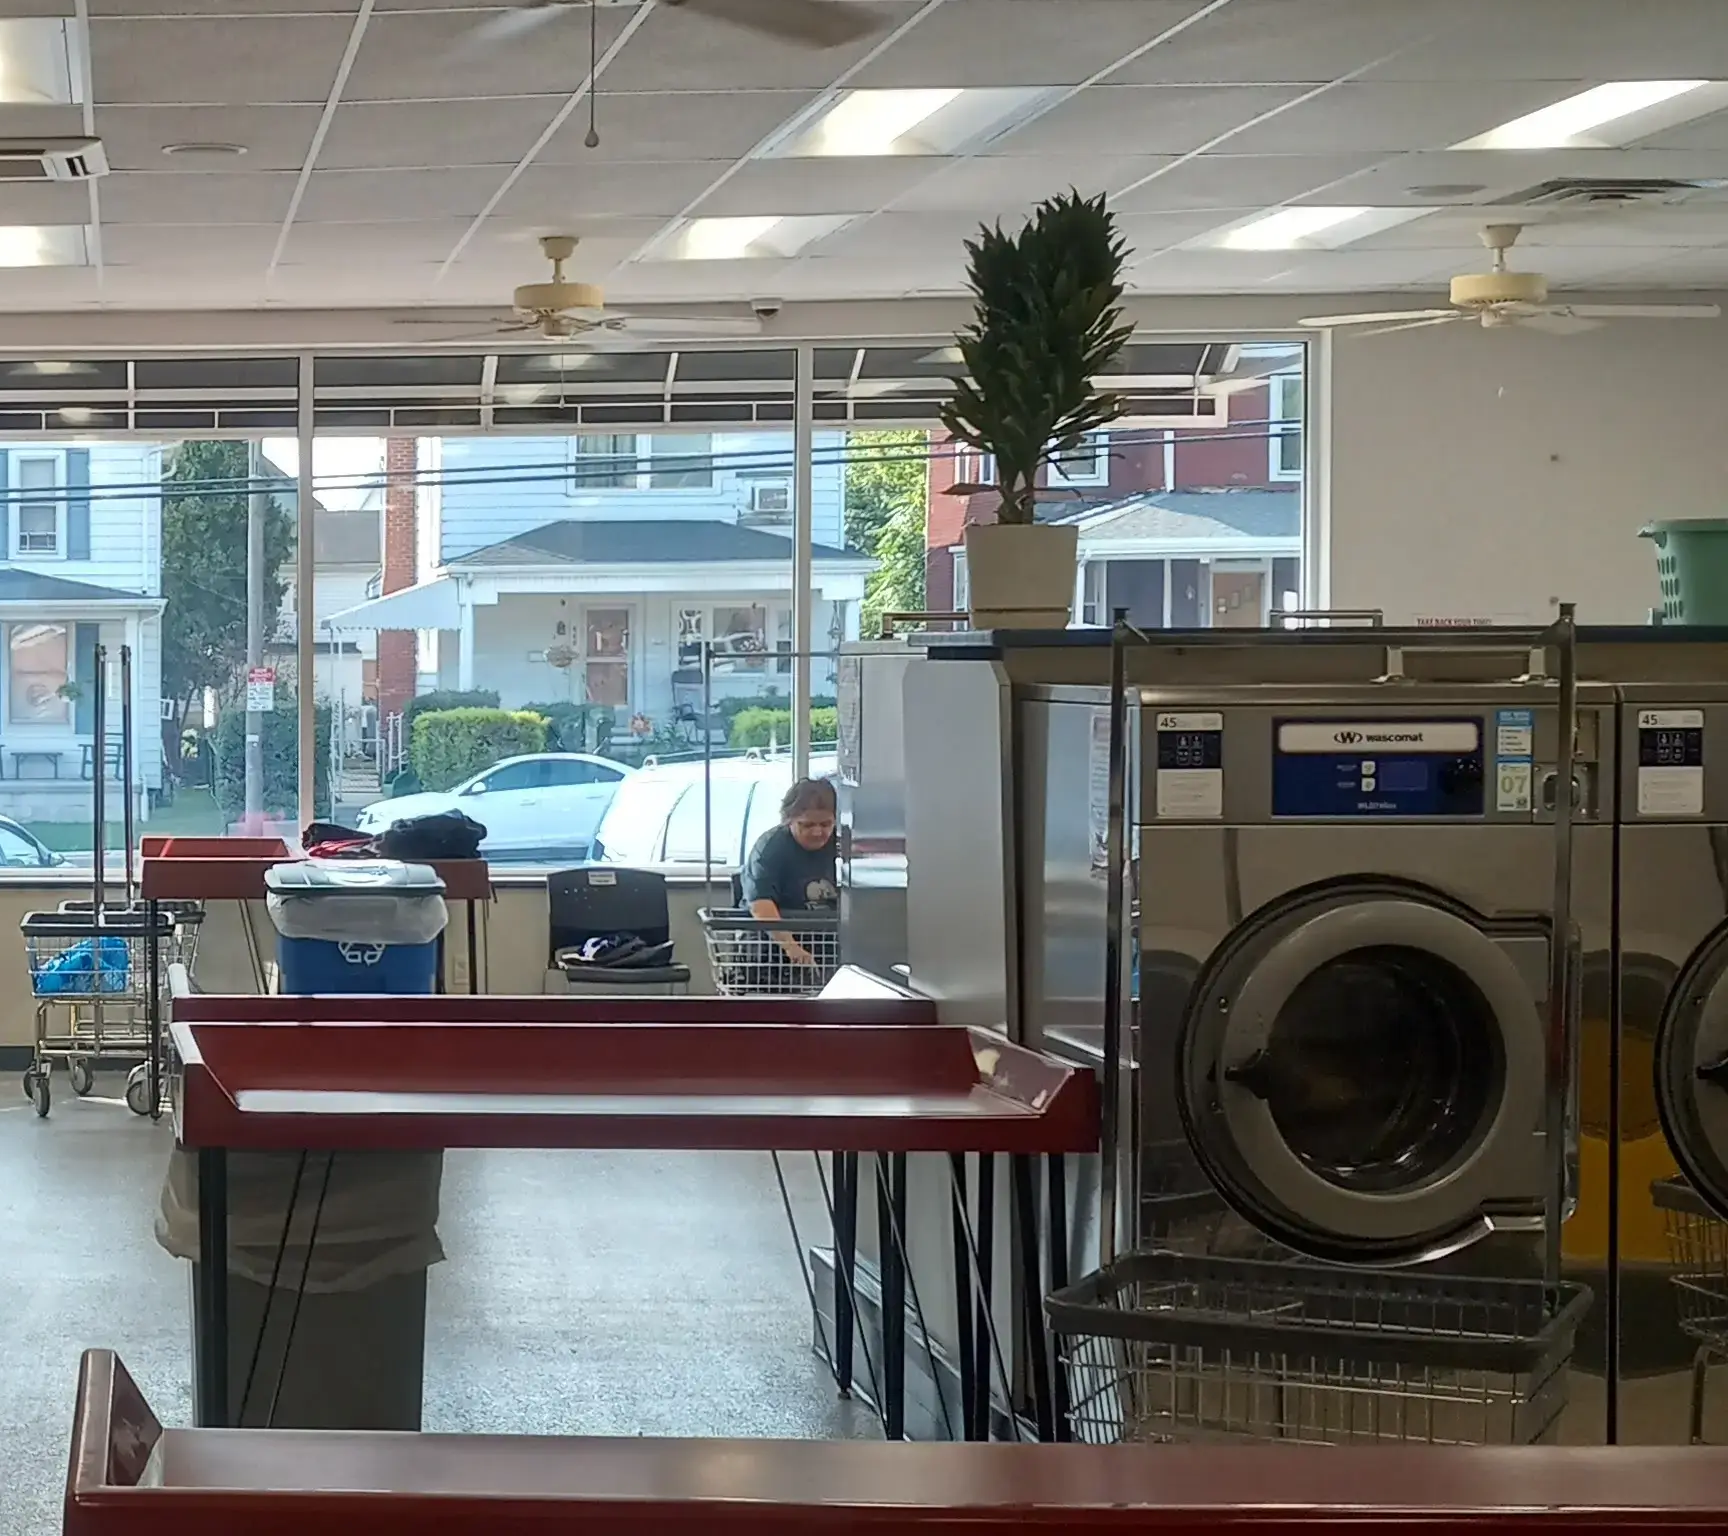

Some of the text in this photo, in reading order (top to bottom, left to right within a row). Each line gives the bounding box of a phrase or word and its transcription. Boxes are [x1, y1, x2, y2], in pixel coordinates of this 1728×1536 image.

[1160, 717, 1178, 728] 45
[1641, 714, 1659, 726] 45
[1366, 732, 1424, 742] wascomat
[1500, 775, 1528, 794] 07
